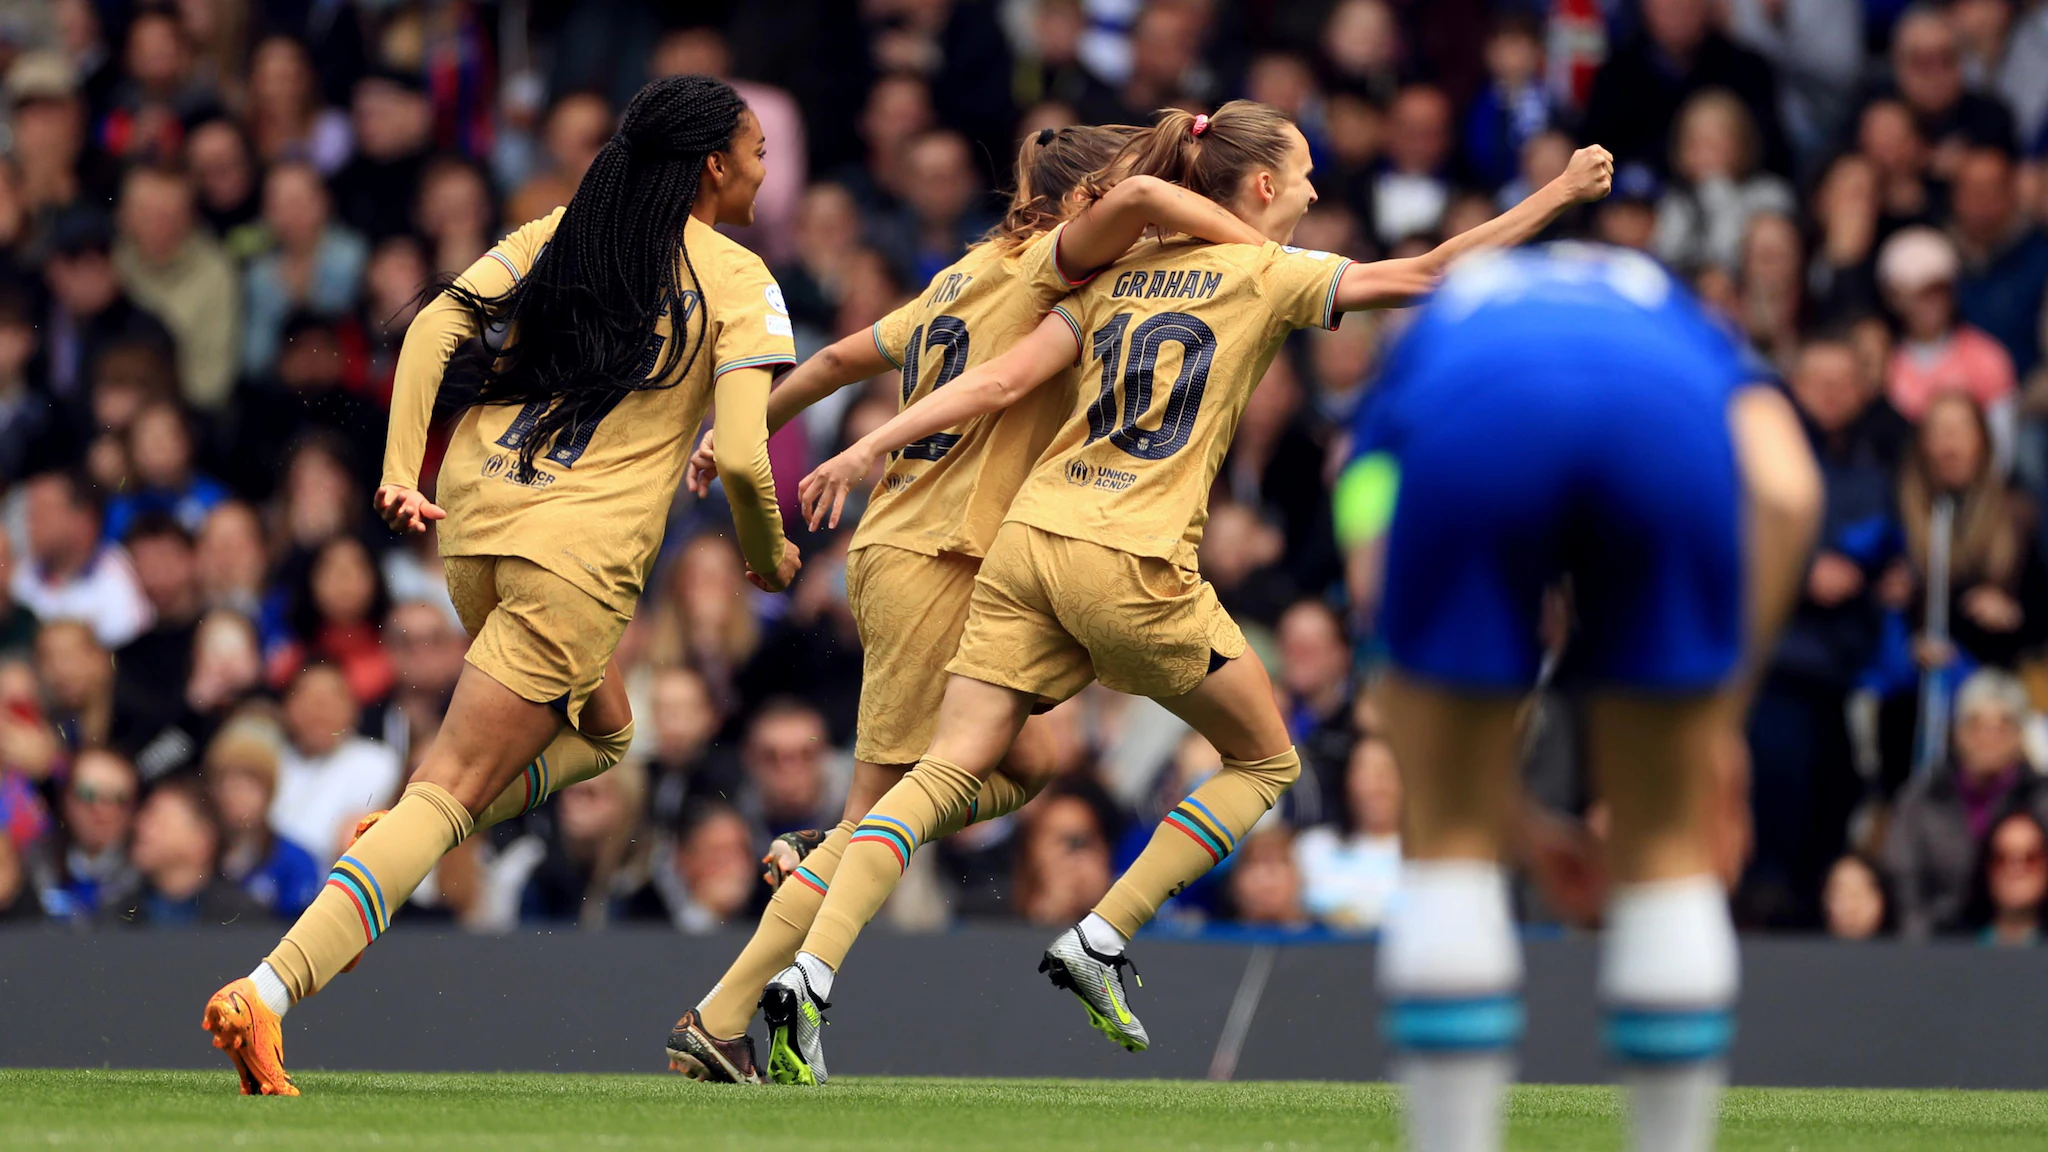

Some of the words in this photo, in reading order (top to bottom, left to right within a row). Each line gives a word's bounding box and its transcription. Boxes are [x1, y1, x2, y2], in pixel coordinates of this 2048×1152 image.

[1111, 269, 1223, 300] GRAHAM
[1083, 311, 1218, 460] 10
[1097, 465, 1138, 484] UNHCR
